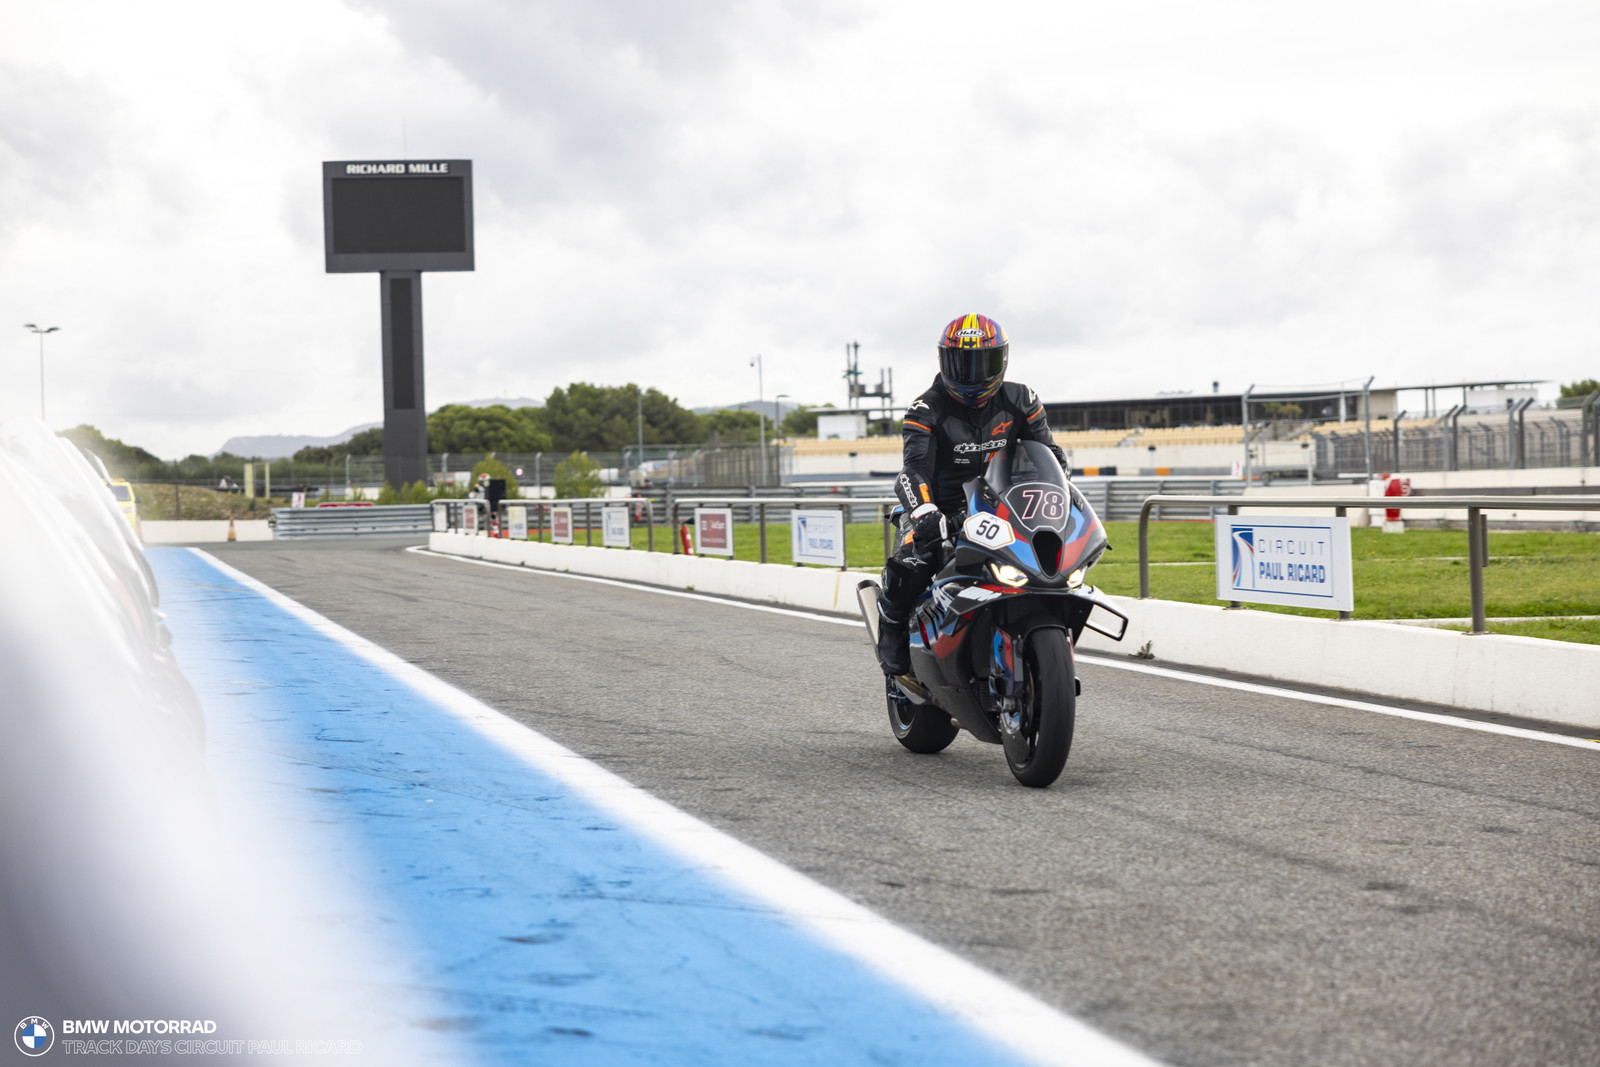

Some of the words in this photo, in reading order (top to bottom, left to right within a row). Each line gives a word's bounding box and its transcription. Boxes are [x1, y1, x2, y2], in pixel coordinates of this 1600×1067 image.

[346, 163, 405, 174] RICHARD
[408, 163, 449, 174] MILLE
[1021, 489, 1065, 520] 78
[976, 519, 1000, 540] 50
[1258, 539, 1325, 555] CIRCUIT
[1259, 561, 1284, 580] PAUL
[1287, 563, 1326, 583] RICARD
